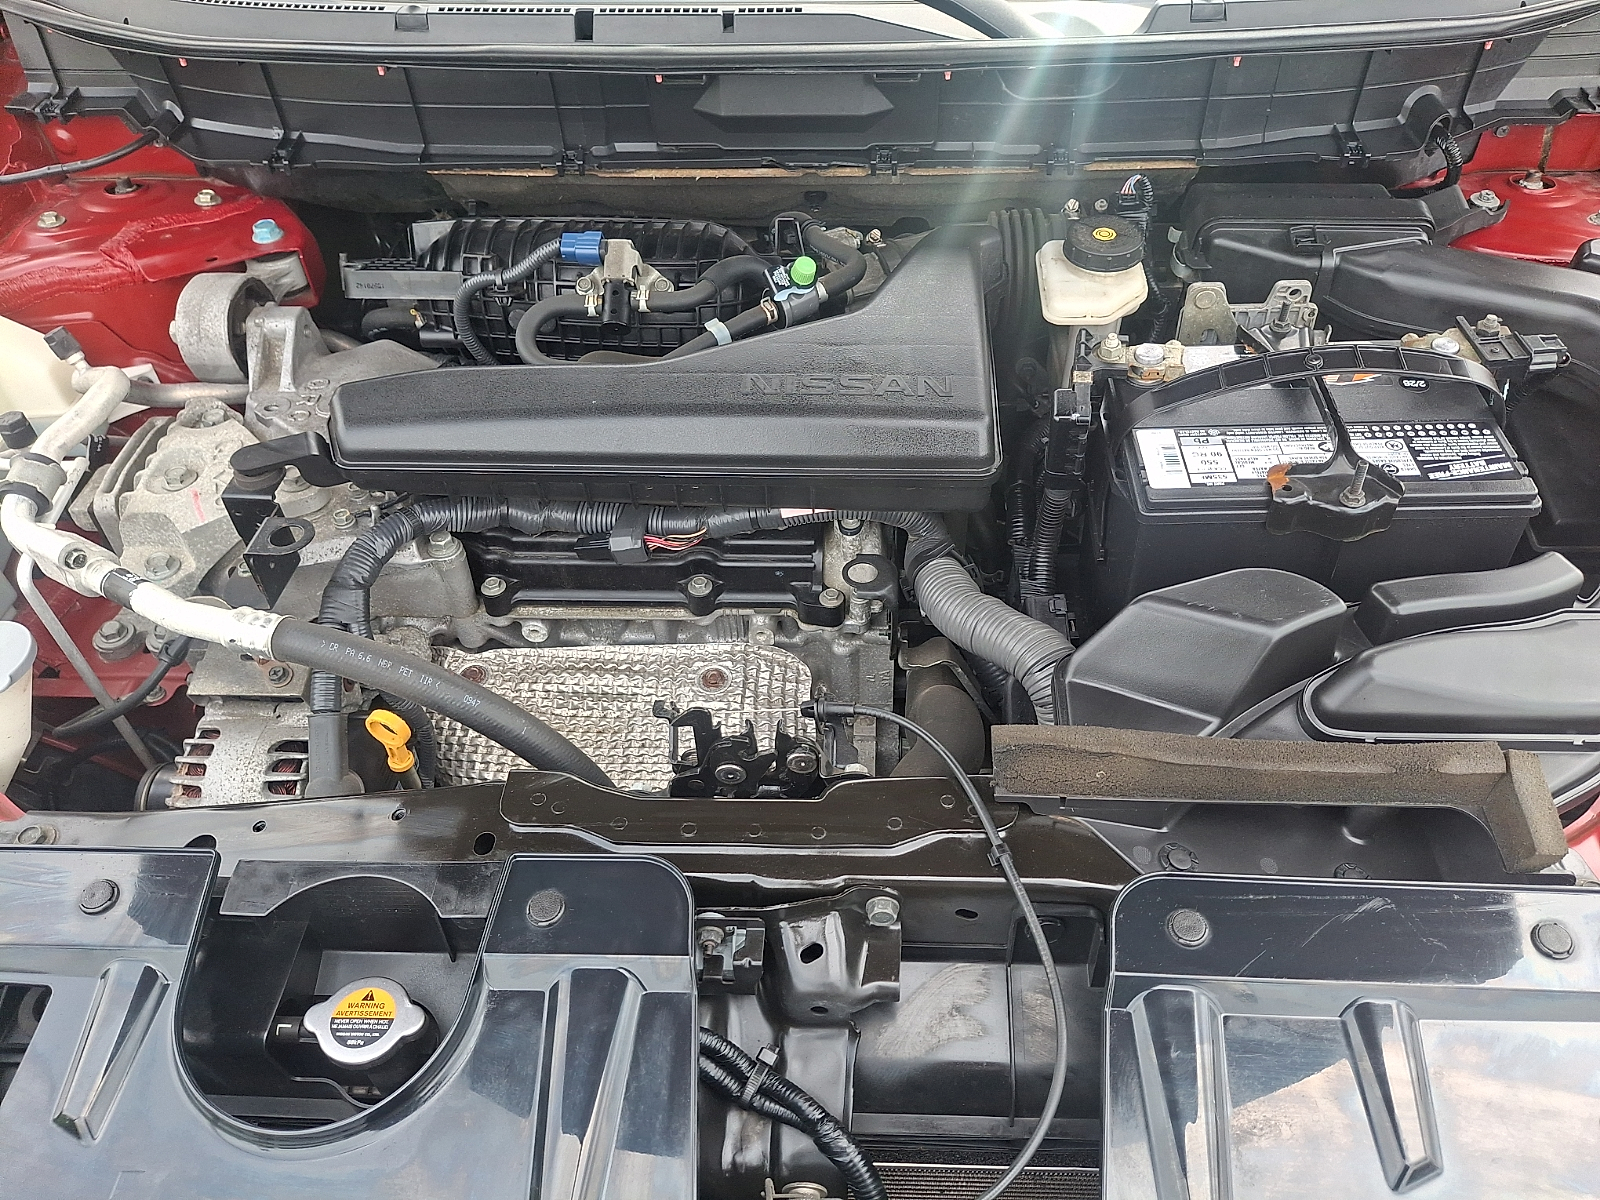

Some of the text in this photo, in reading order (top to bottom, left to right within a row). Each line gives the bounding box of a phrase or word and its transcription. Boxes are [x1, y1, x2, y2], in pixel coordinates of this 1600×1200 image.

[742, 374, 954, 398] NISSAN
[345, 647, 356, 657] PA
[463, 695, 480, 708] 0947
